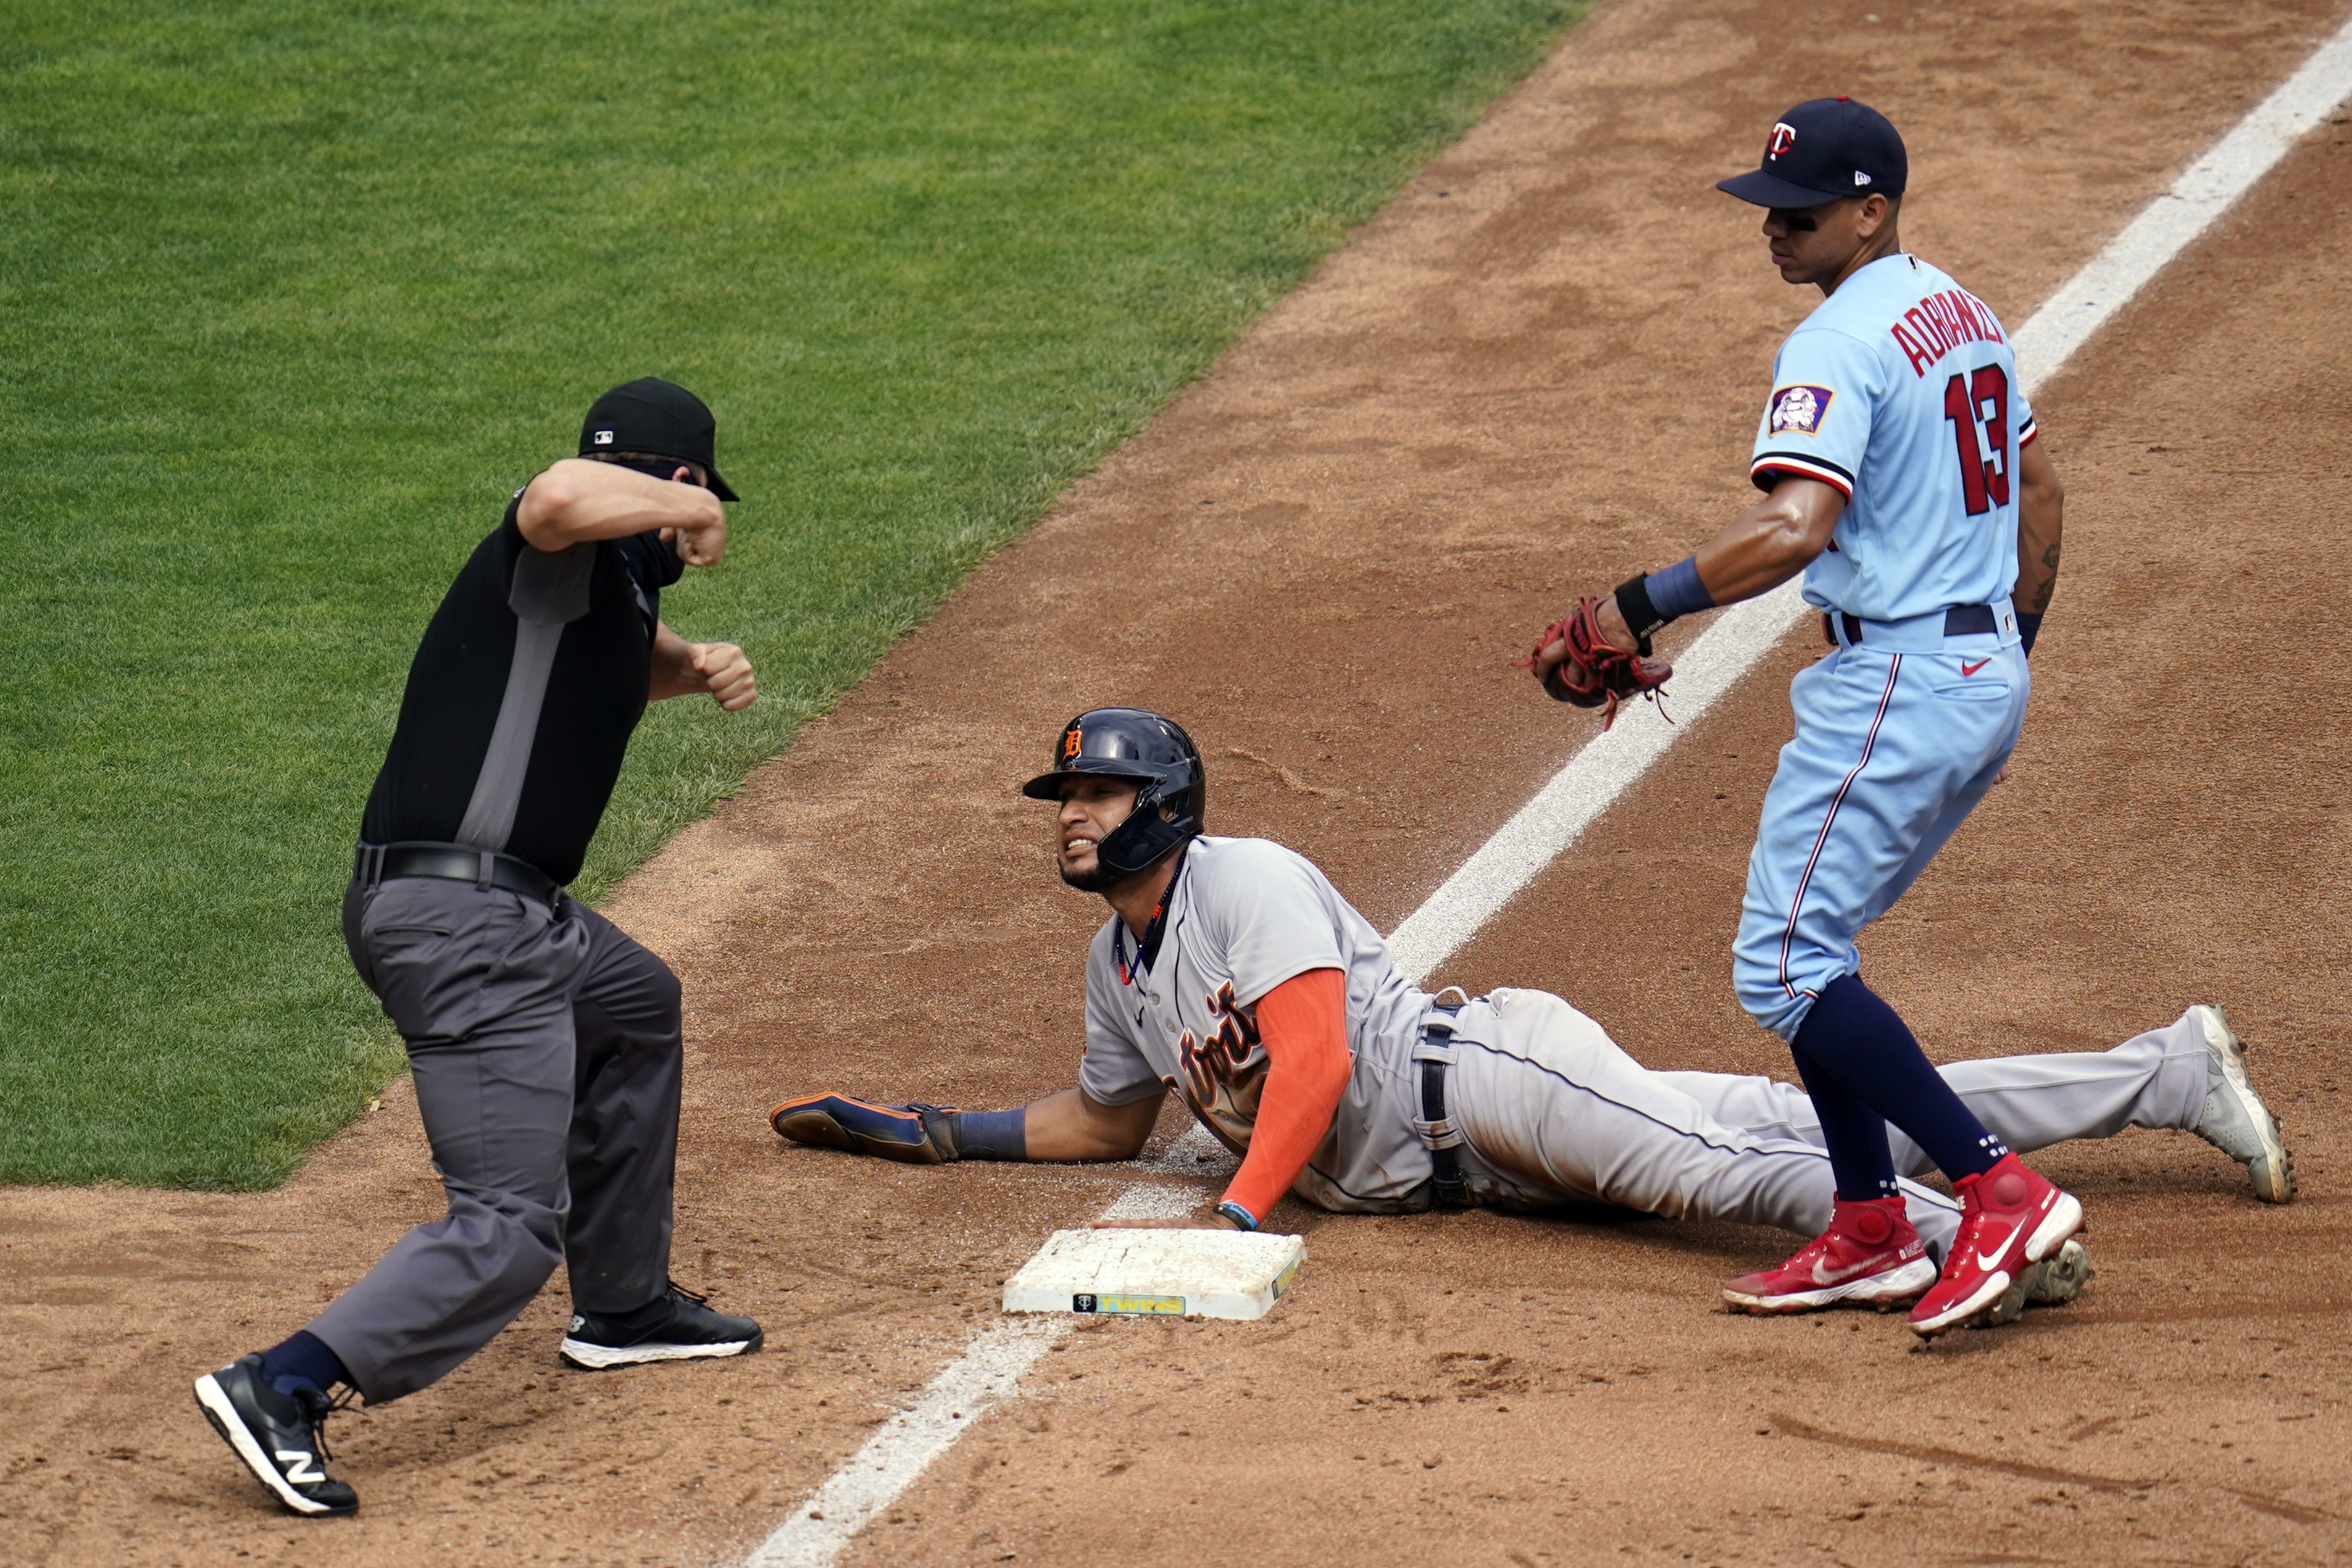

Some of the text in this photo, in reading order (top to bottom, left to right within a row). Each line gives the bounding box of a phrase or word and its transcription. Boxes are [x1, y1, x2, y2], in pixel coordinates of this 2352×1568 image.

[1945, 362, 2010, 517] 13
[1062, 728, 1083, 761] D
[1161, 978, 1262, 1109] troit
[1098, 1296, 1183, 1313] TWINS
